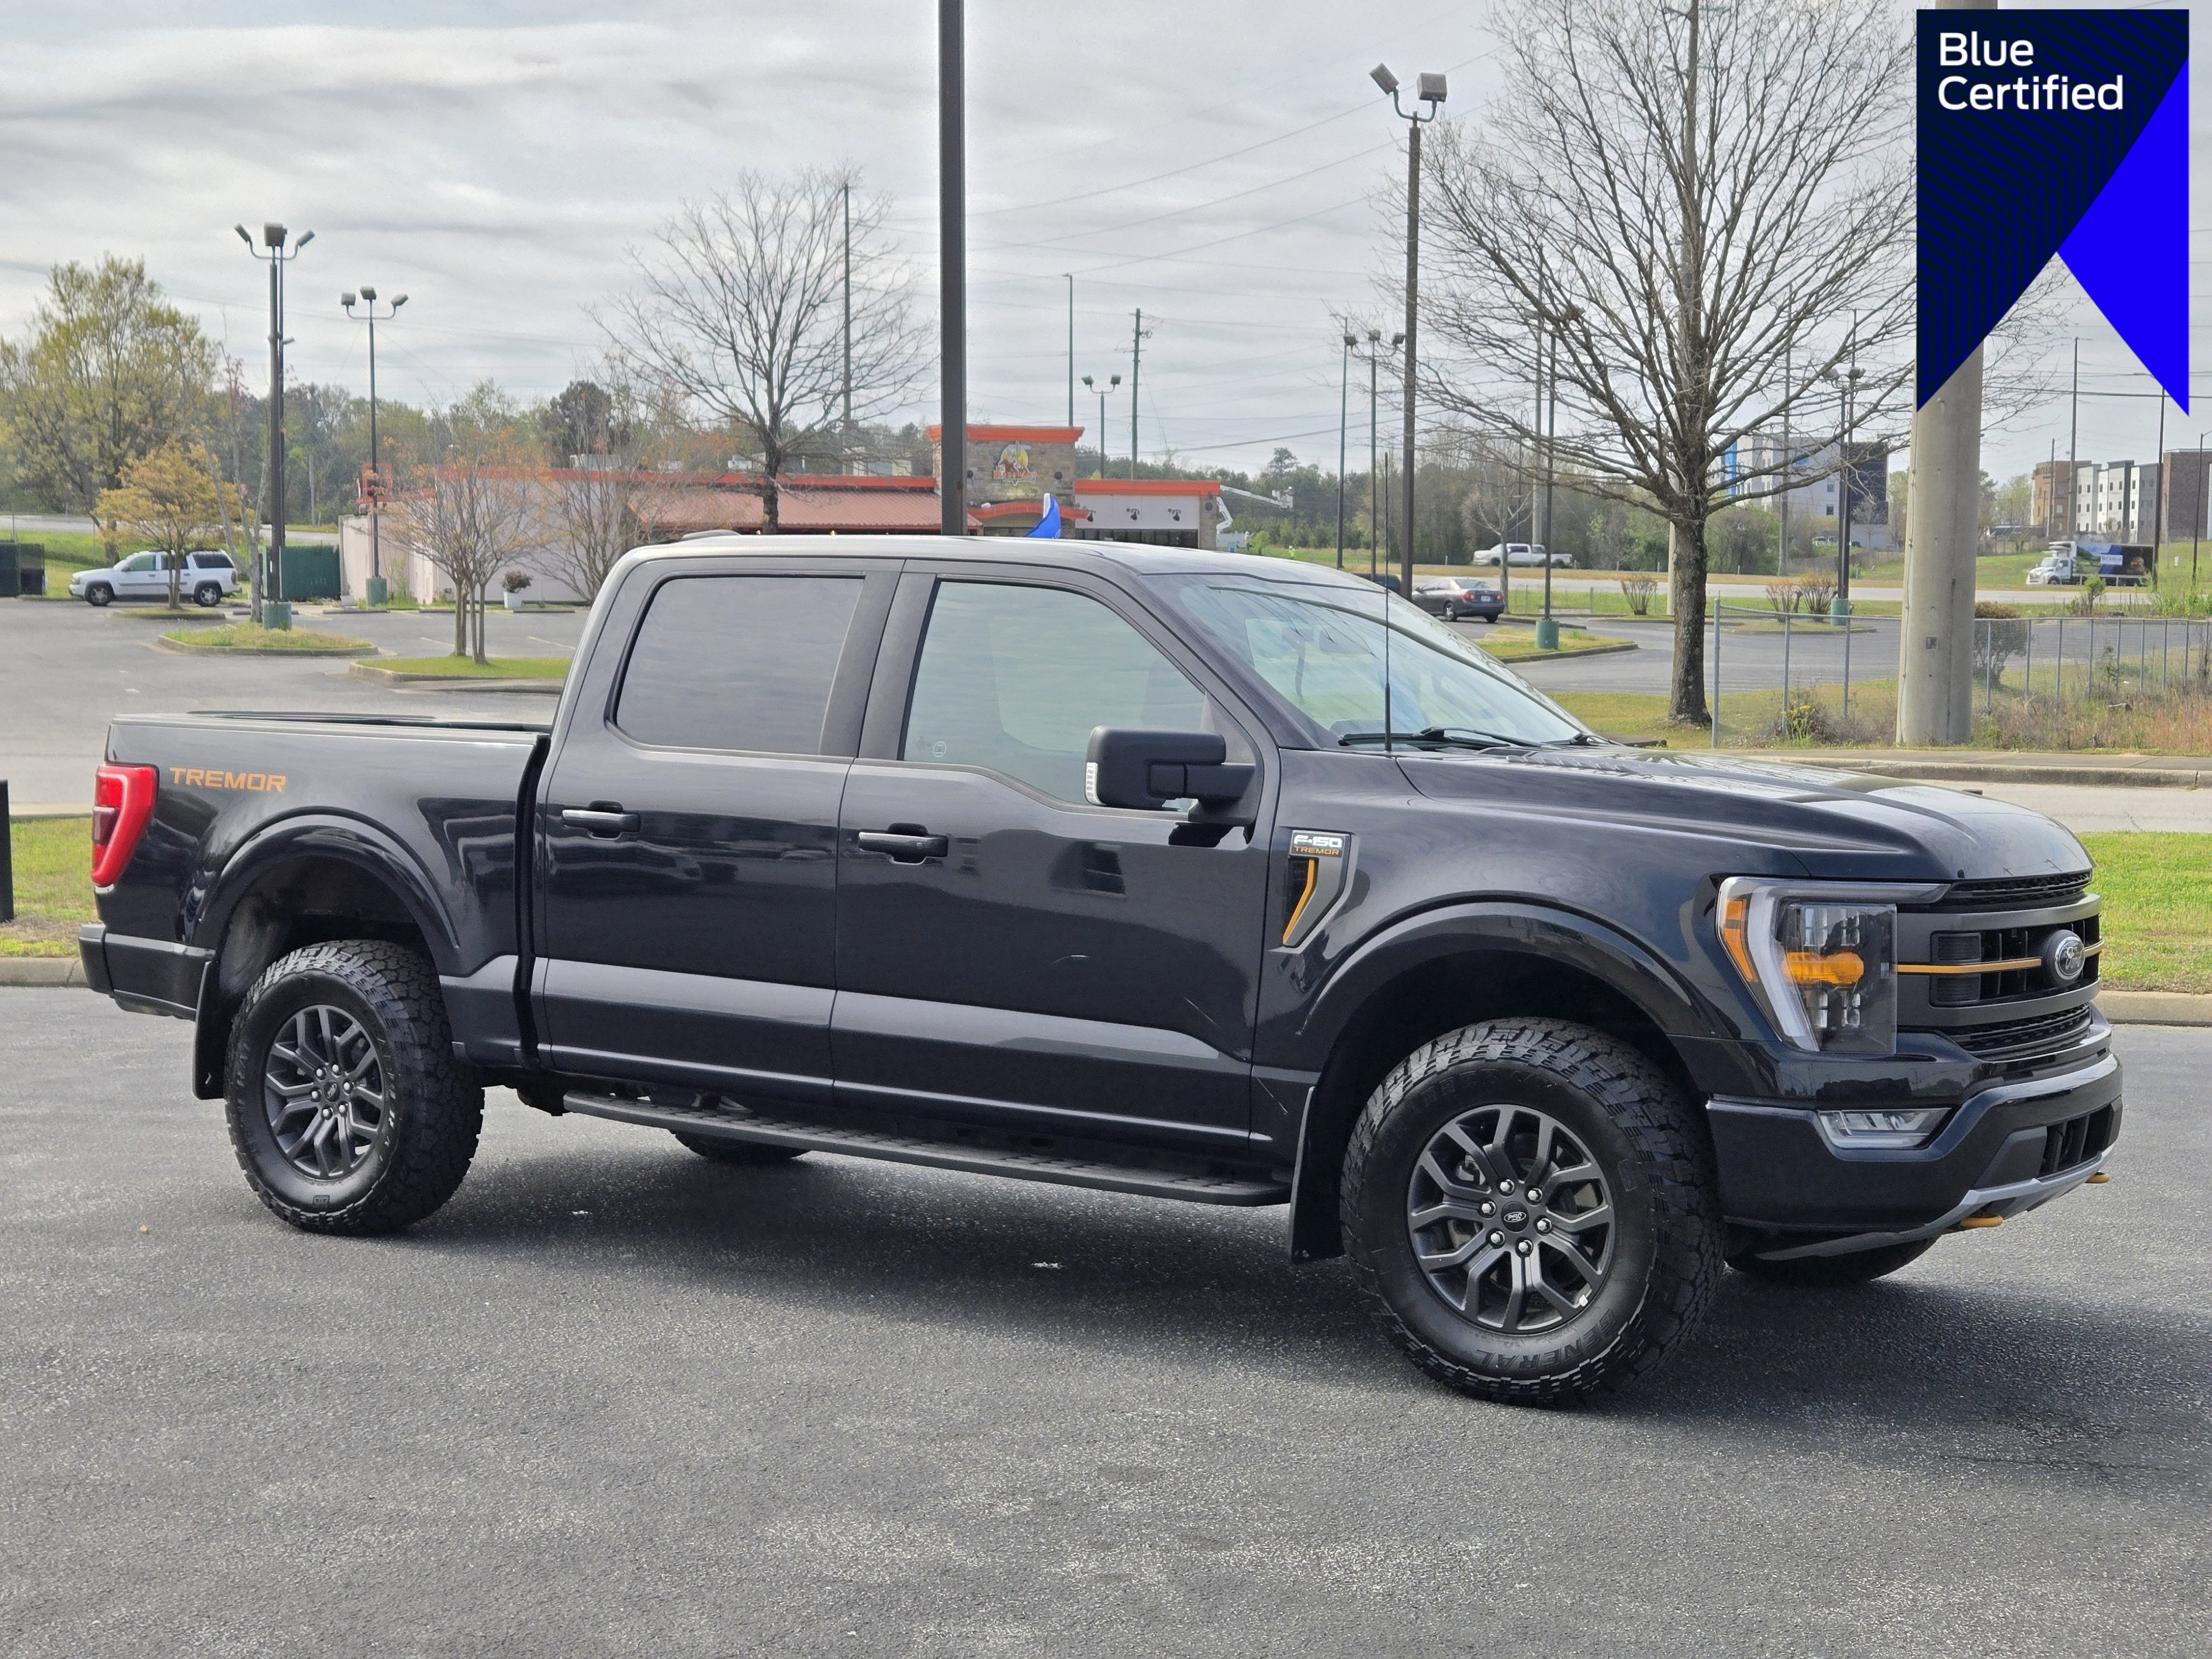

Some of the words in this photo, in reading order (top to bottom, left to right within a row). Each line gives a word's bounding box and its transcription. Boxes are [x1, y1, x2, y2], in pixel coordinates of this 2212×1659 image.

[169, 767, 286, 792] TREMOR
[1294, 834, 1343, 847] F-150
[1296, 846, 1339, 855] TREMOR
[1476, 1308, 1616, 1370] GENERAL
